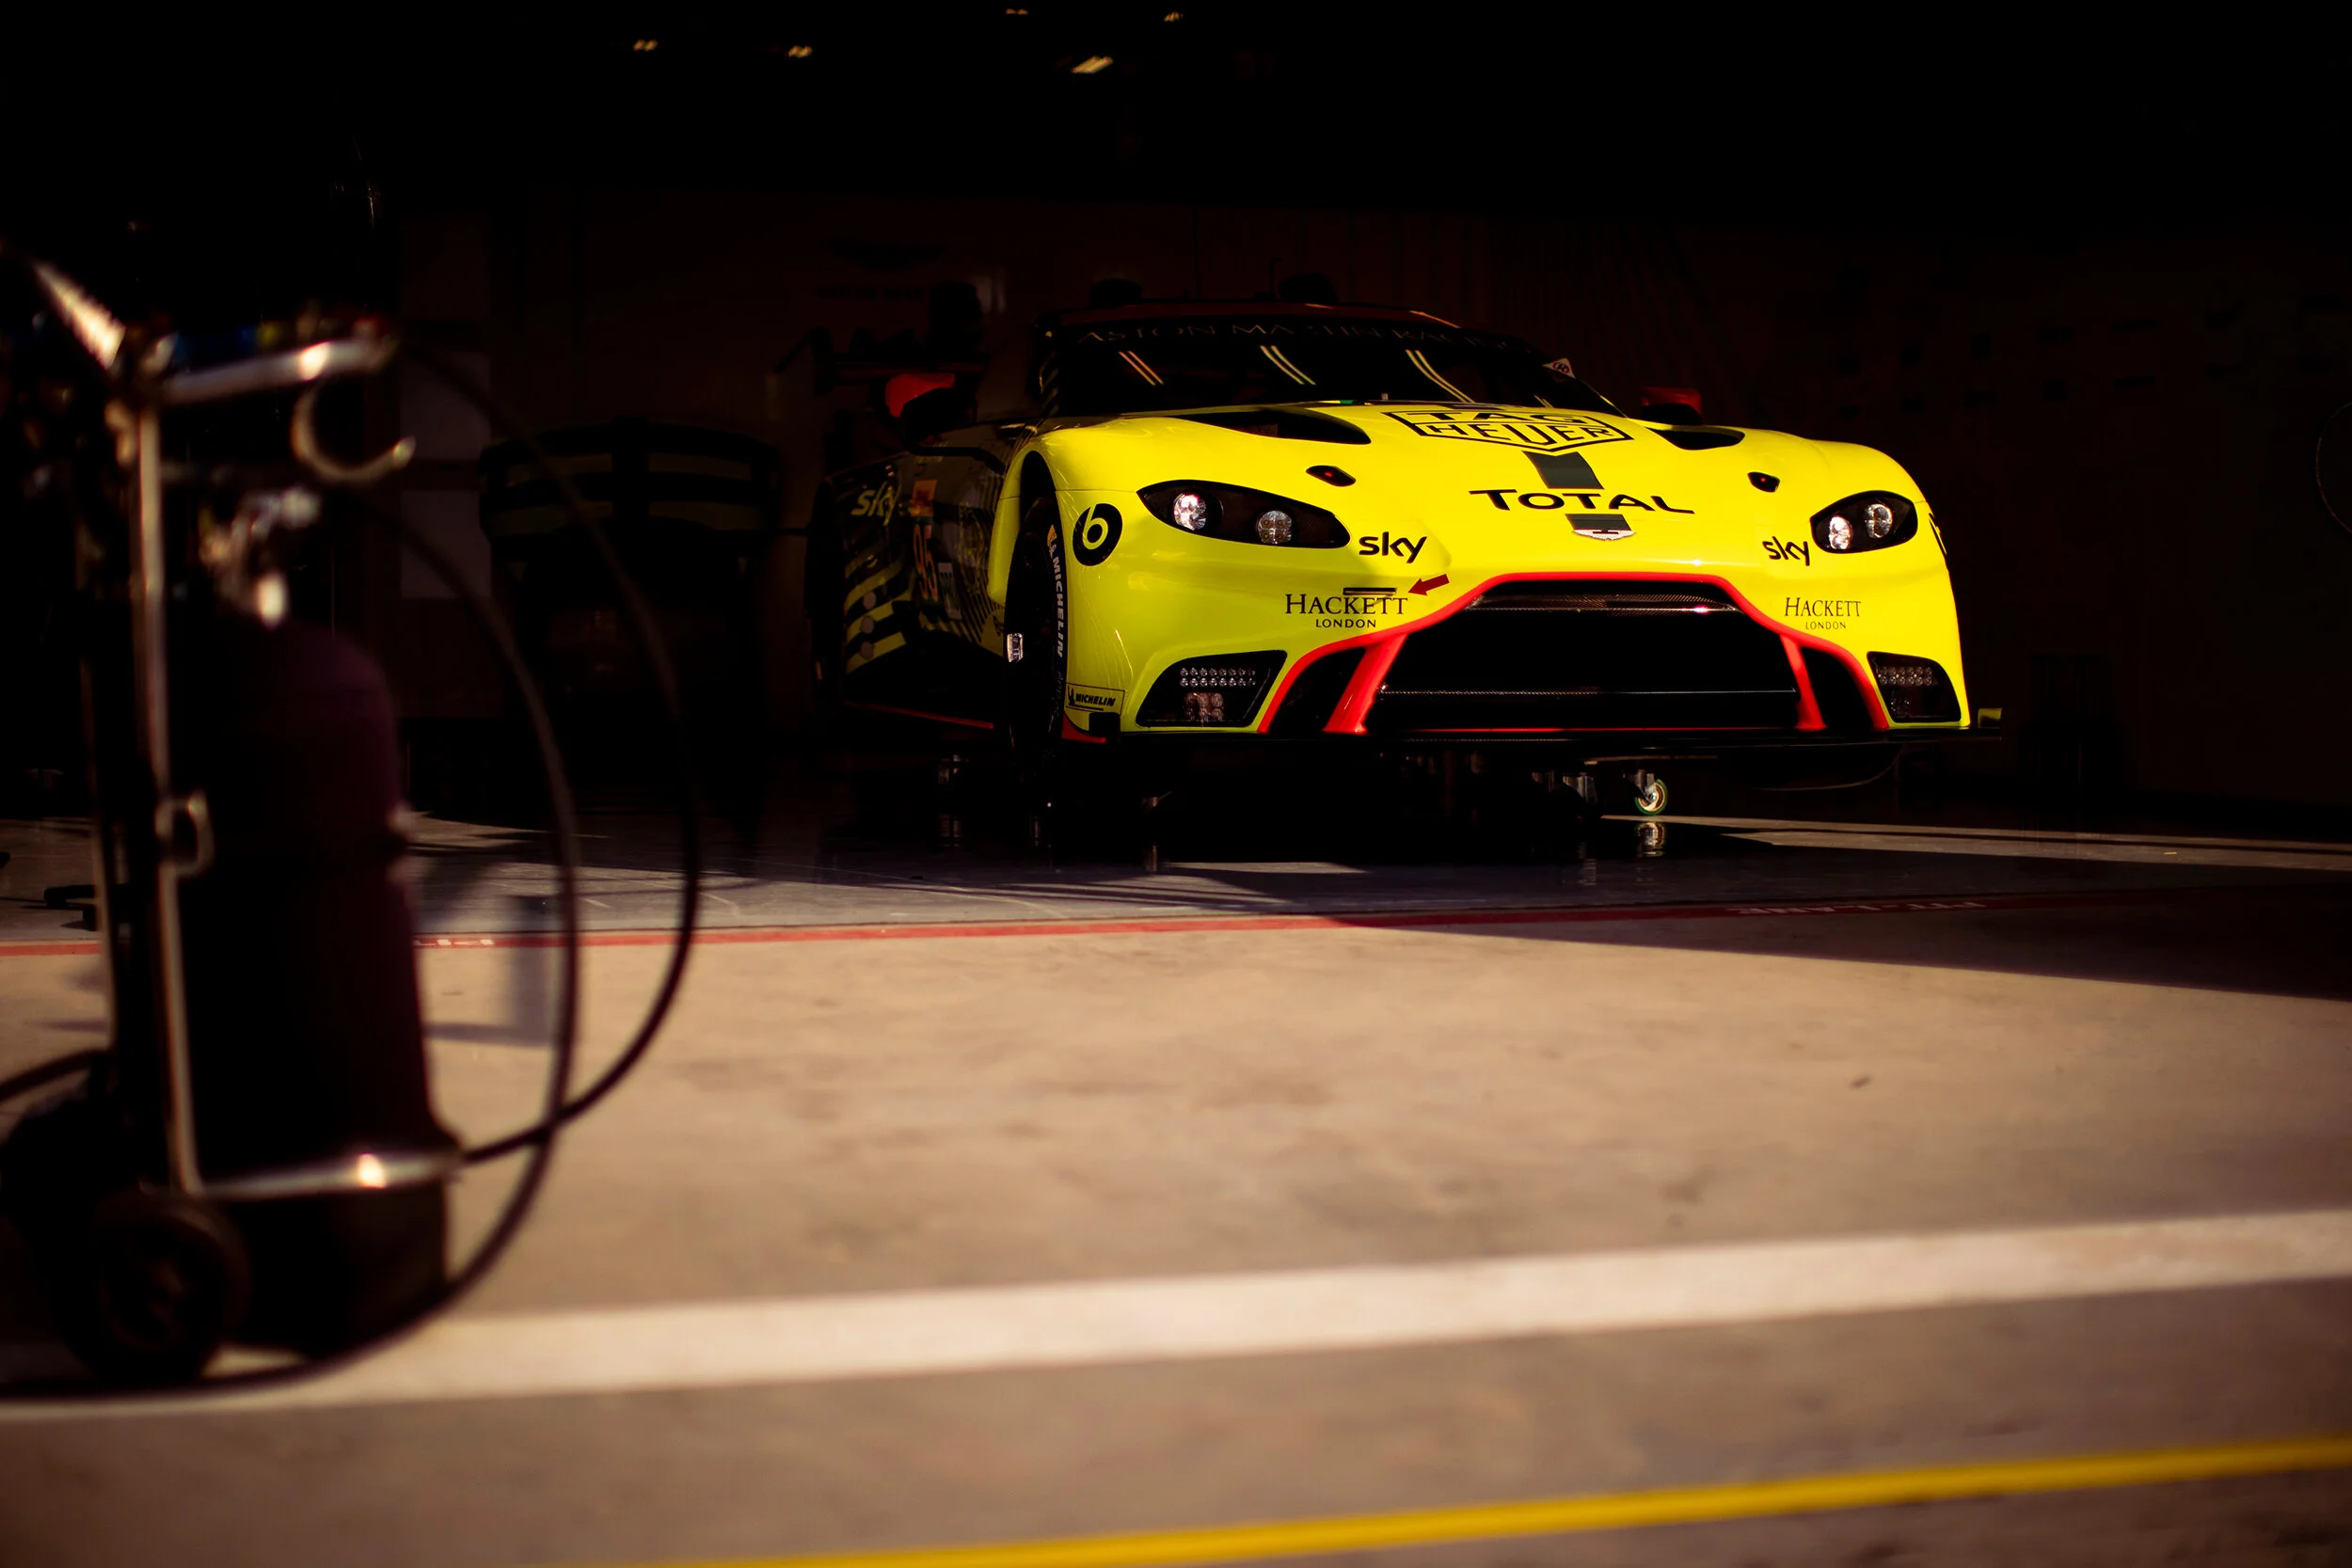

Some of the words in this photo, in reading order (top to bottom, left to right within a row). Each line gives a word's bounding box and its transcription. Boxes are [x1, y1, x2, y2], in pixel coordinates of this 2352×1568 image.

[1407, 412, 1588, 424] TAG
[1424, 424, 1612, 445] HEUER
[1469, 489, 1694, 515] TOTAL
[1359, 531, 1428, 564] sky
[1762, 536, 1811, 566] sky
[1052, 556, 1065, 658] MICHELIN
[1285, 594, 1408, 614] HACKETT
[1785, 597, 1862, 617] HACKETT
[1315, 619, 1376, 628] LONDON
[1805, 621, 1847, 630] LONDON
[1075, 693, 1116, 706] MICHELIN
